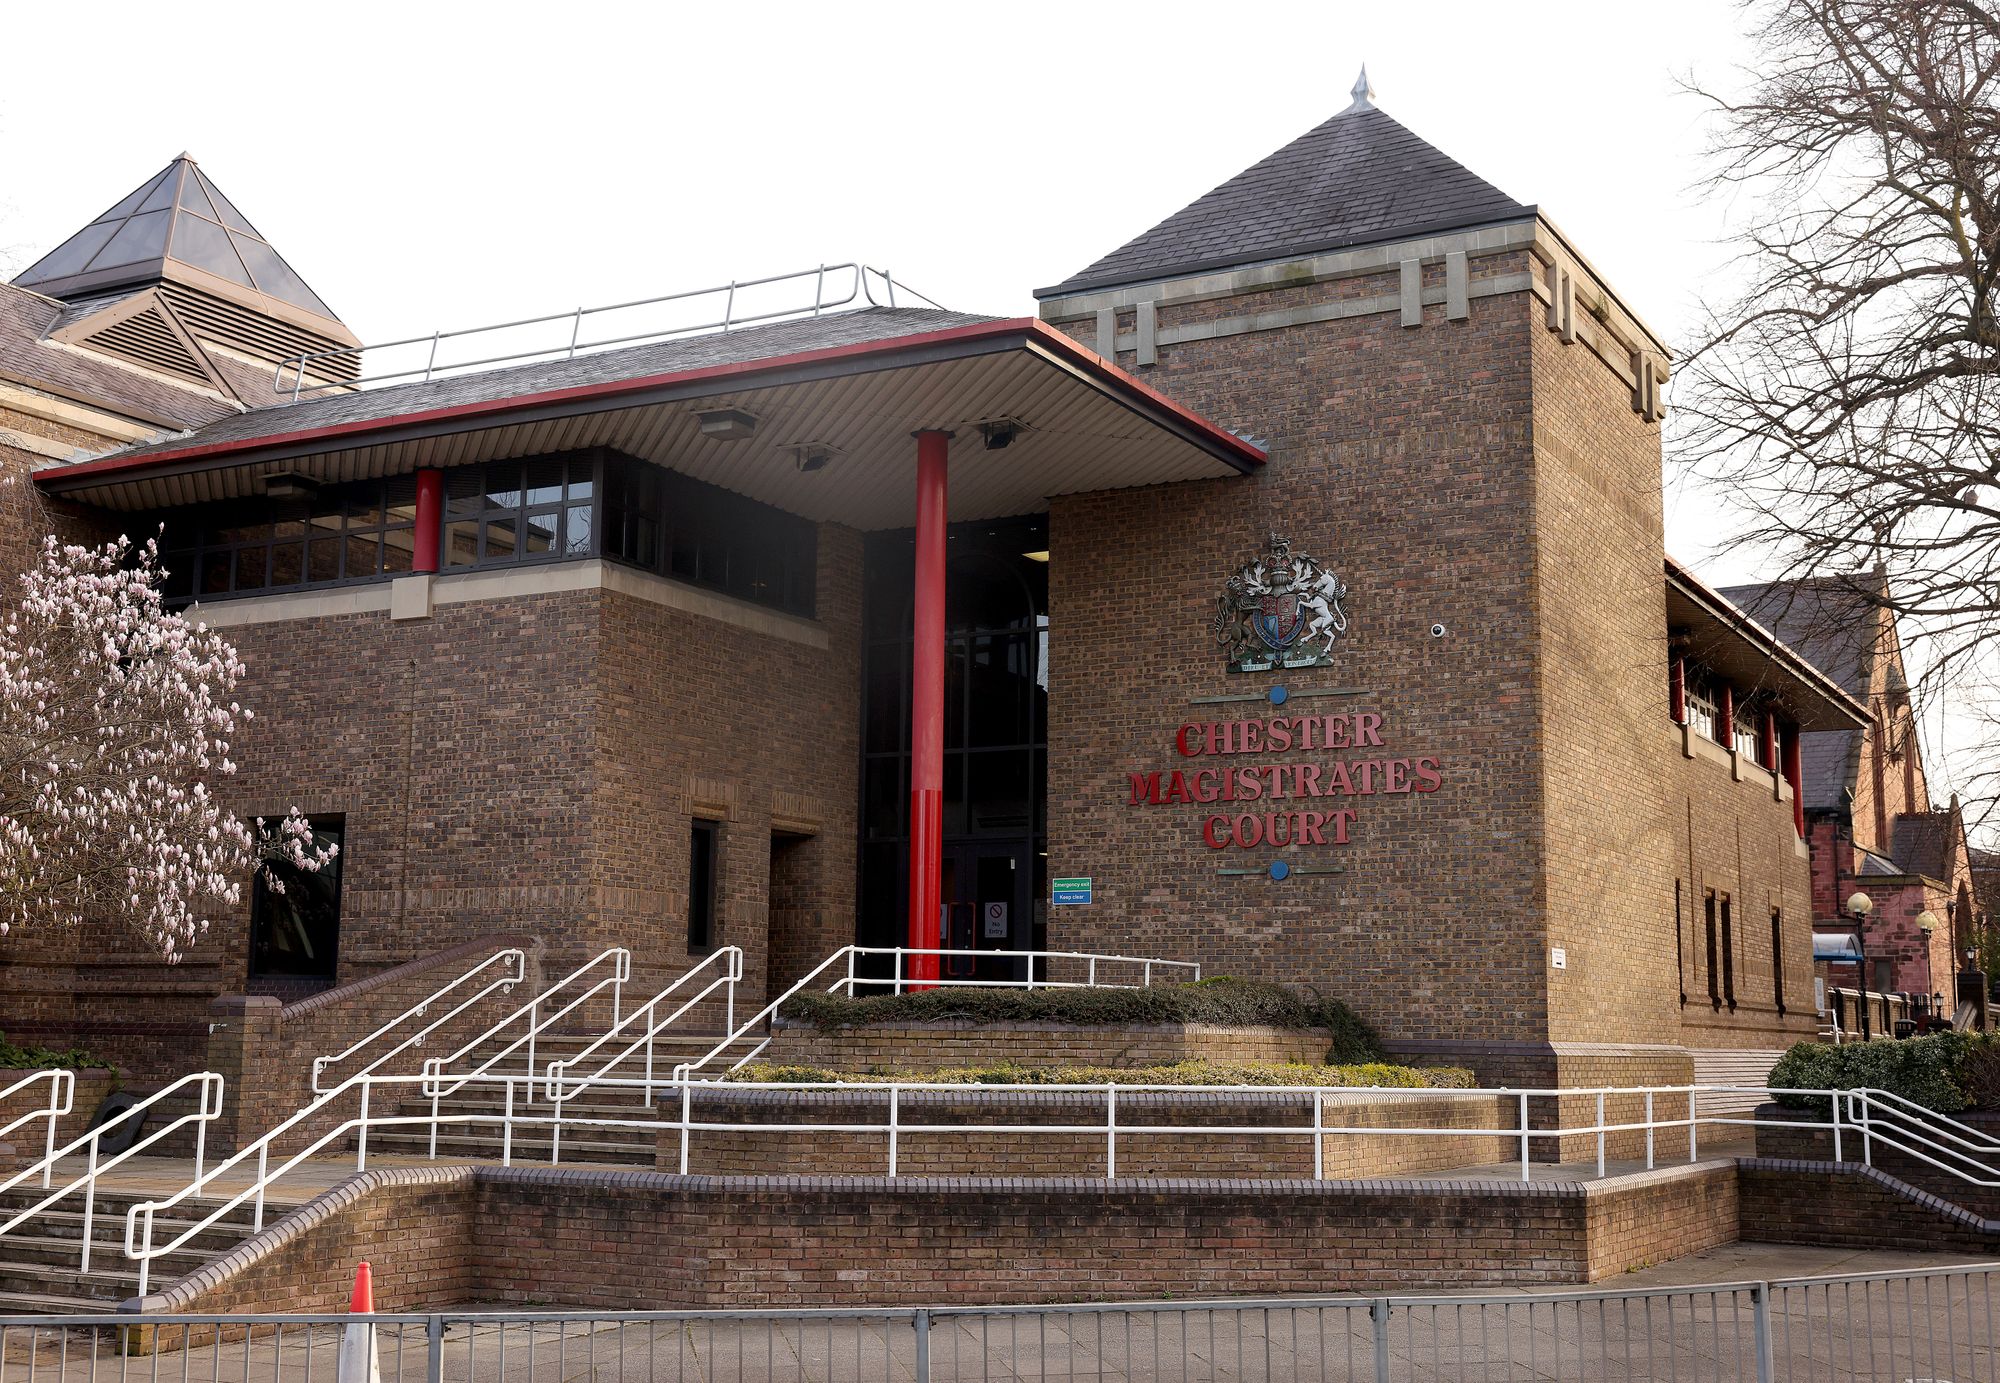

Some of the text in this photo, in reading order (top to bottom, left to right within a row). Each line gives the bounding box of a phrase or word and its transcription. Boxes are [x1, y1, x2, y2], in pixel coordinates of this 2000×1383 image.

[1176, 713, 1385, 757] CHESTER
[1128, 756, 1443, 805] MAGISTRATES
[1203, 809, 1357, 849] COURT
